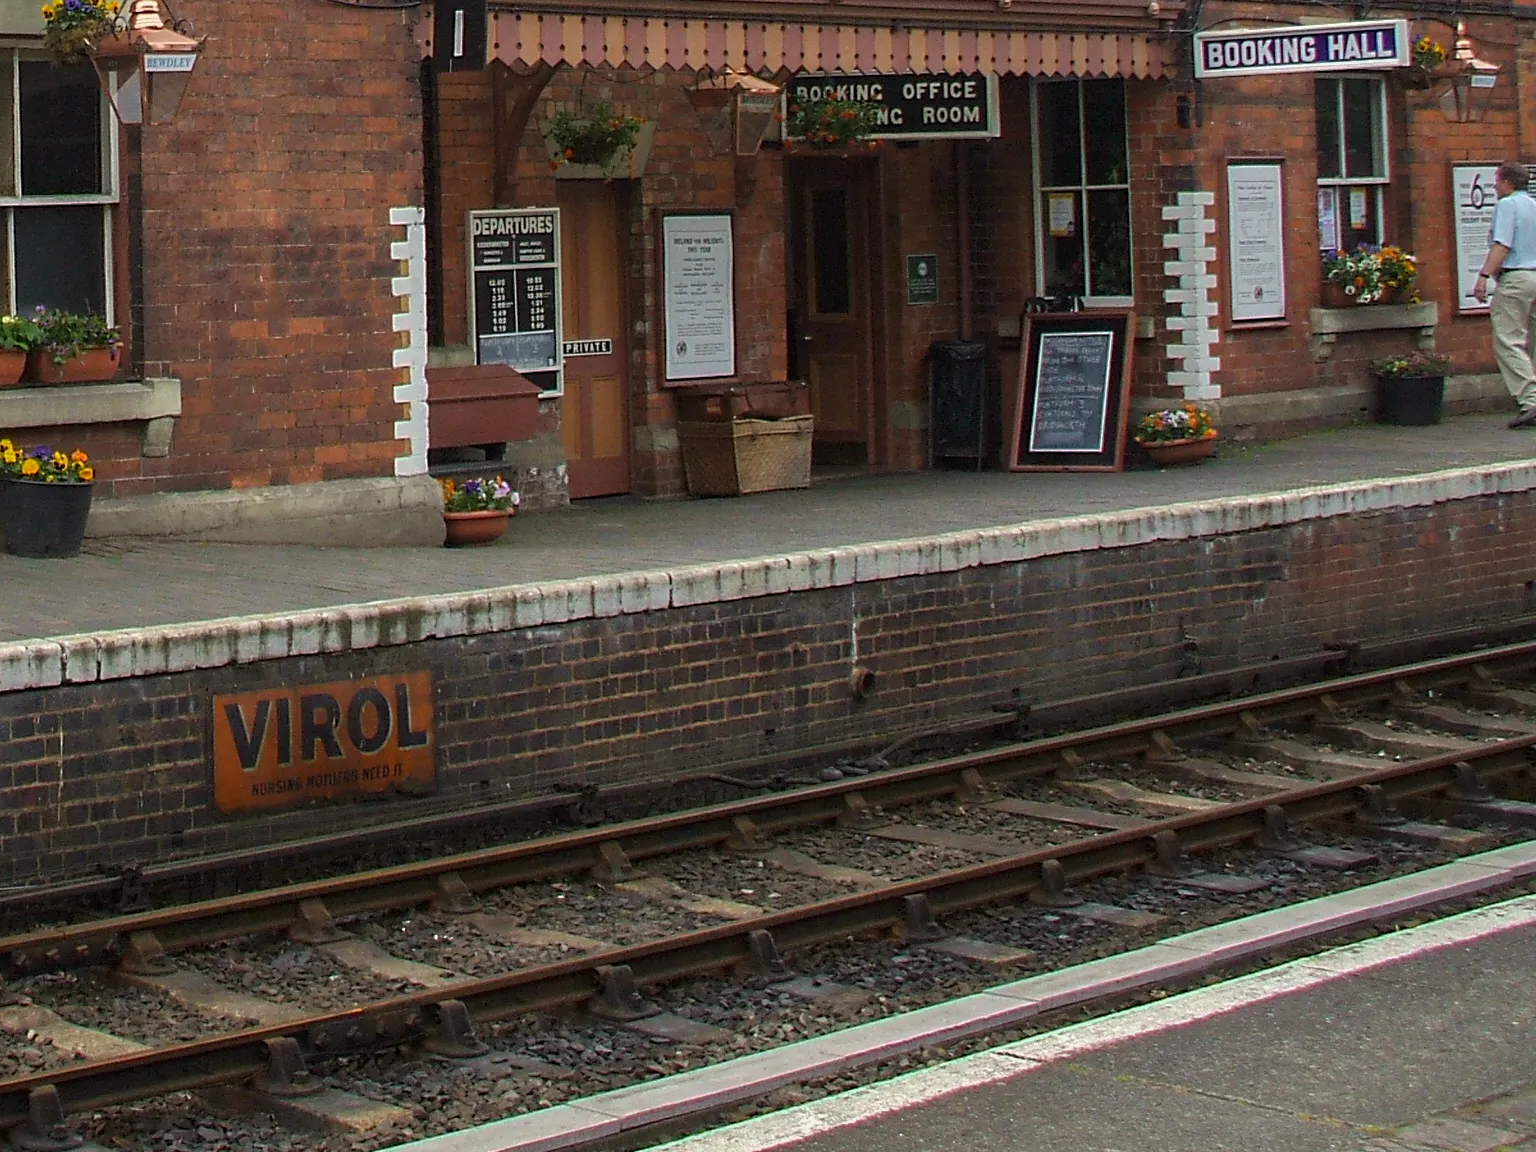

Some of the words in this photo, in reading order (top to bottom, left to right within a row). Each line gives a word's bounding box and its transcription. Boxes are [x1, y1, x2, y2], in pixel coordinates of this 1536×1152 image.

[1208, 37, 1314, 68] BOOKING
[1327, 31, 1392, 60] HALL
[147, 57, 192, 68] BEWDLEY
[902, 82, 976, 99] OFFICE
[923, 106, 980, 124] ROOM
[1471, 173, 1484, 210] 6
[473, 215, 553, 235] DEPARTURES
[566, 342, 607, 354] PRIVATE
[224, 683, 431, 772] VIROL
